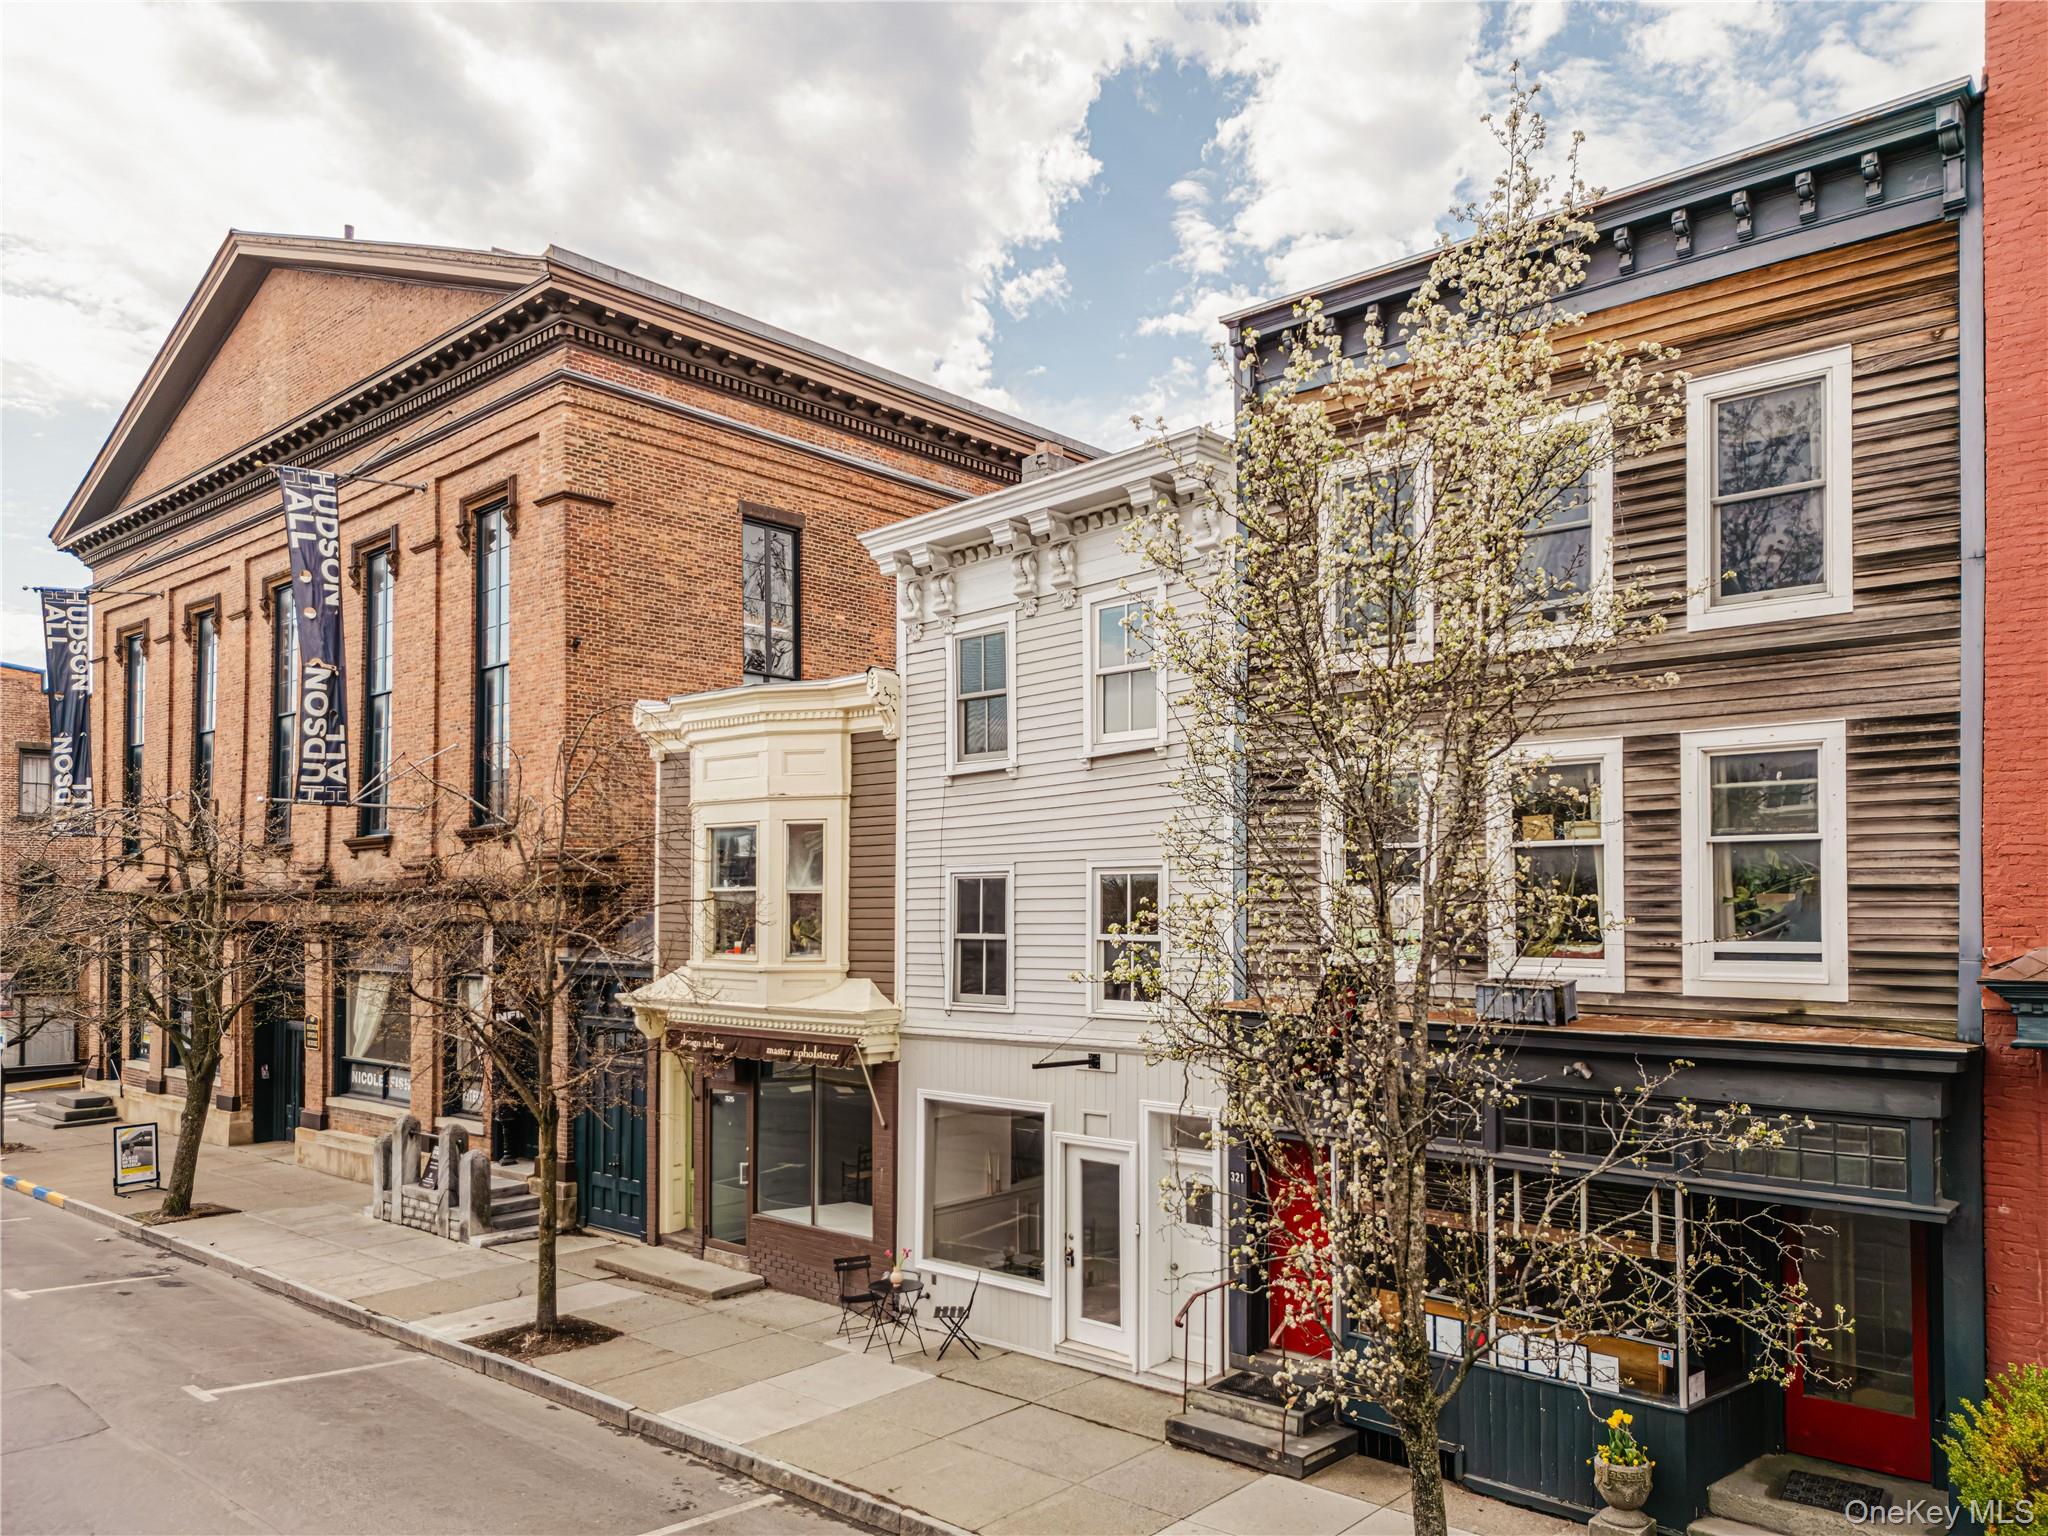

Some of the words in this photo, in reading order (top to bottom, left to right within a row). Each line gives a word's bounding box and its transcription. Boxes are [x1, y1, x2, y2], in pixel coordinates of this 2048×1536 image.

[282, 466, 317, 549] HALL
[309, 469, 339, 607] HUDSON
[42, 588, 68, 650] HALL
[66, 588, 90, 692] HUDSON
[299, 667, 330, 805] HUDSON
[323, 724, 348, 807] HALL
[52, 737, 73, 836] DSON
[352, 1071, 383, 1087] NICOLE
[766, 1047, 791, 1057] master
[793, 1044, 839, 1062] upholsterer
[1230, 1171, 1244, 1183] 321
